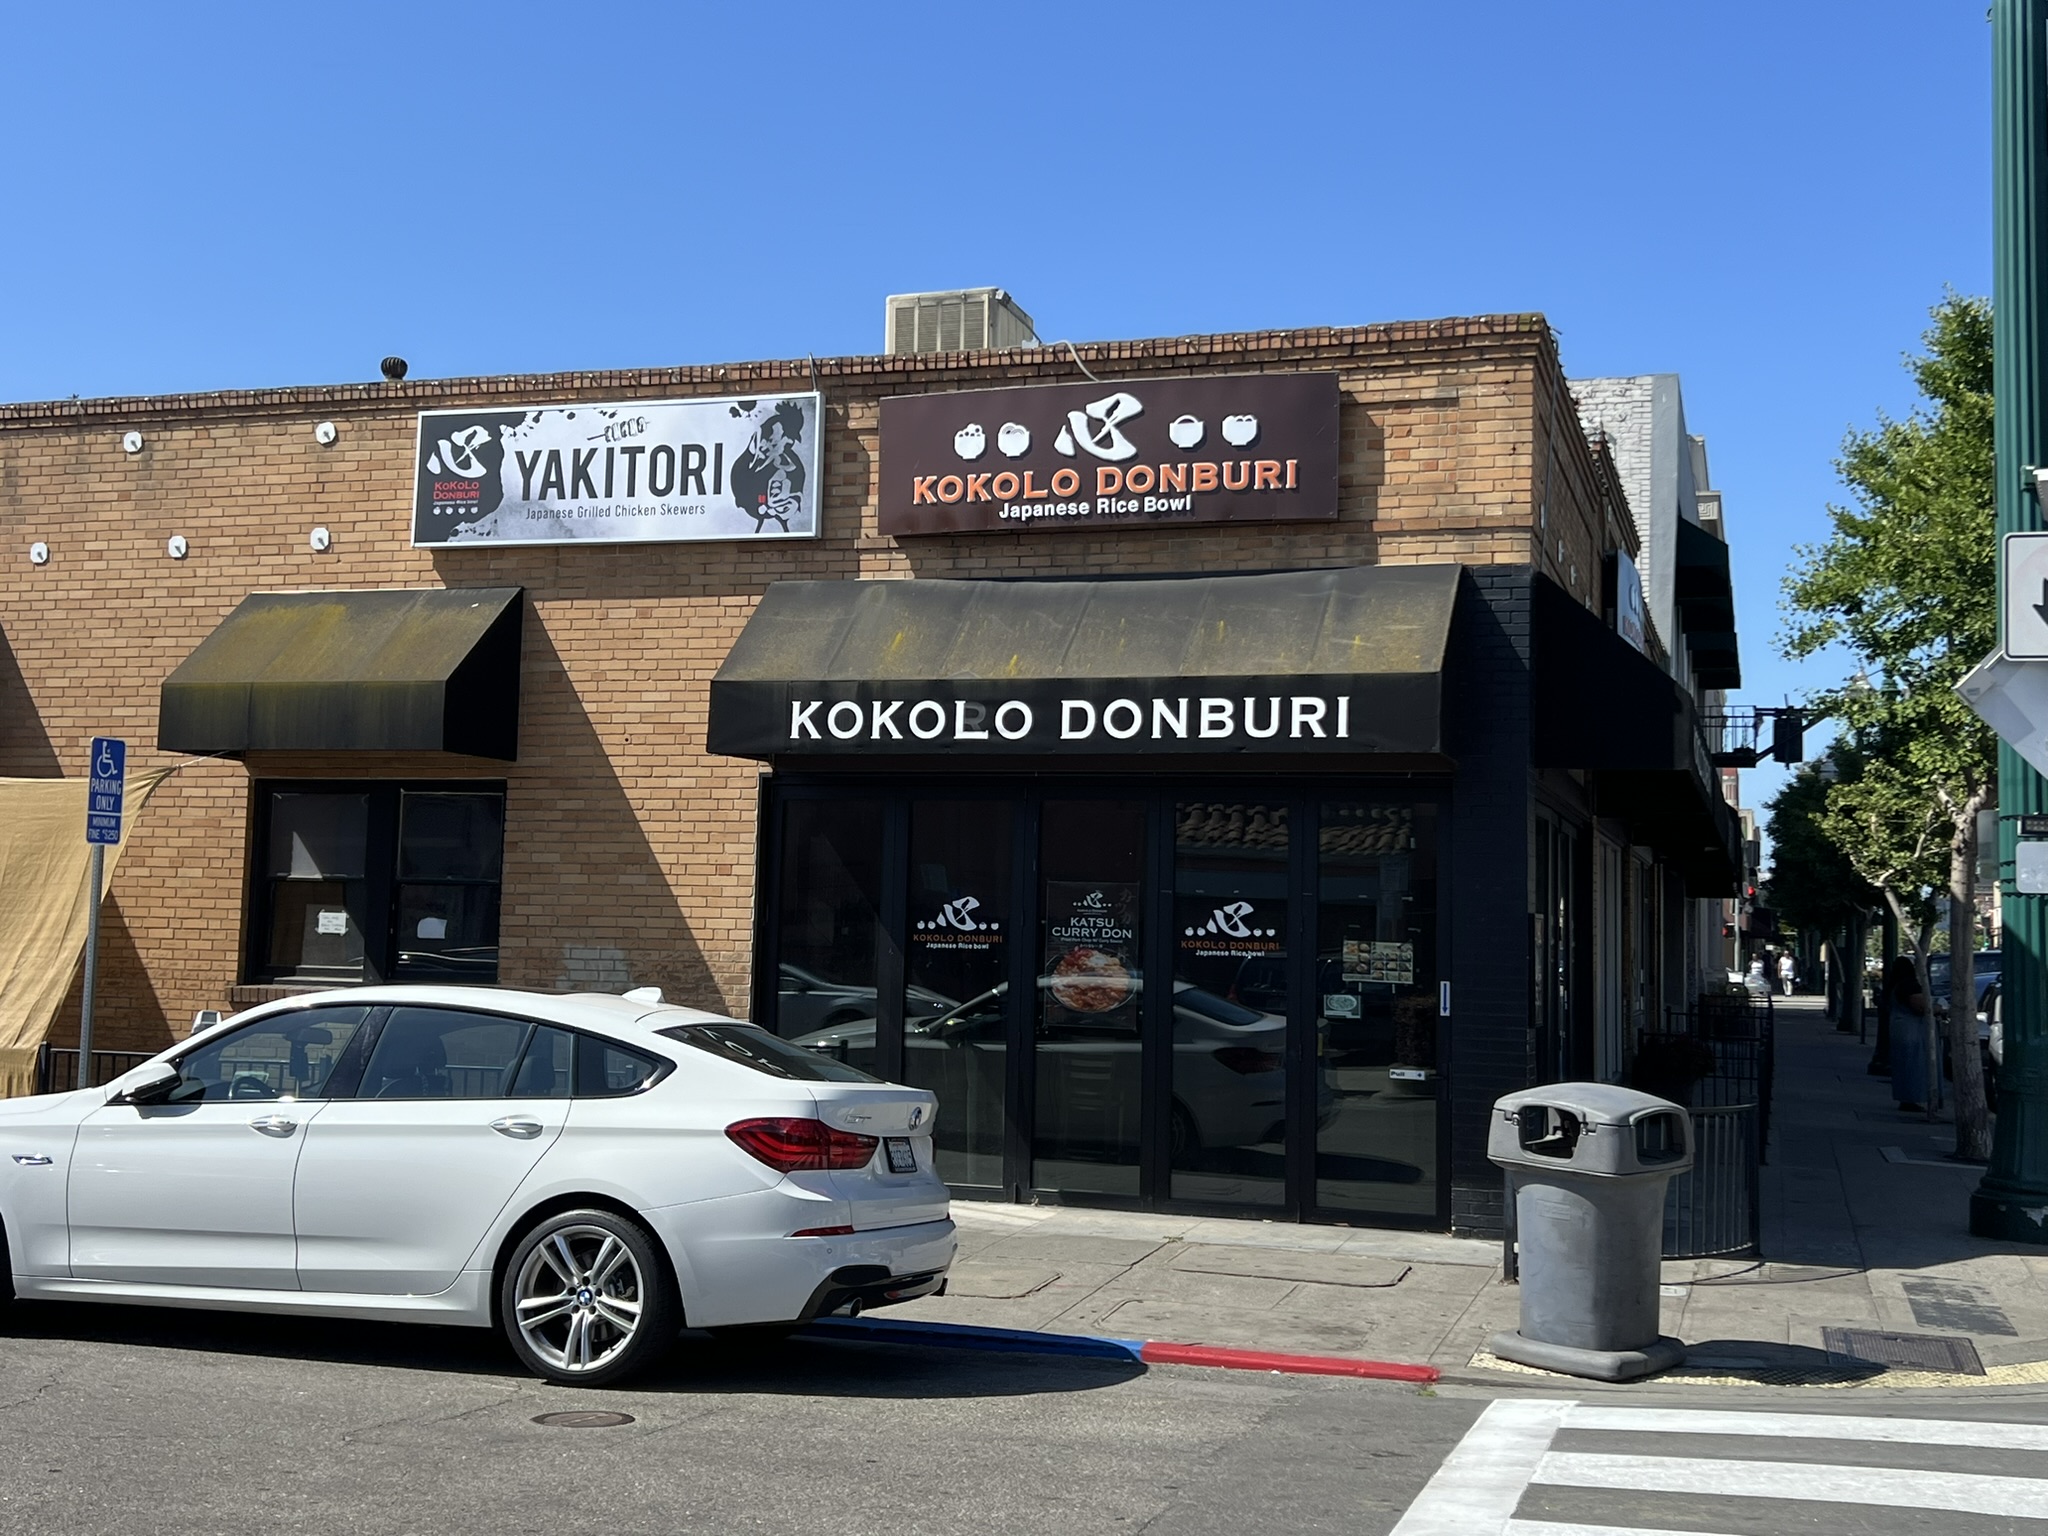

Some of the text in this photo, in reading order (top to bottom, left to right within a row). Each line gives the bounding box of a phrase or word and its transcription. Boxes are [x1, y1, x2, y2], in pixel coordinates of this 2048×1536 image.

[515, 443, 723, 501] YAKITORI
[434, 481, 480, 490] KOKOLO
[913, 459, 1298, 504] KOKOLO DONBURI
[433, 490, 480, 500] DONBURI
[525, 503, 706, 521] Japanese Grilled Chicken Skewers
[999, 494, 1191, 521] Japanese Rice Bowl
[790, 697, 1351, 741] KOKOLO DONBURI
[91, 777, 122, 795] PARKING
[95, 795, 115, 811] ONLY
[92, 815, 117, 828] MINIMUM
[1070, 917, 1115, 928] KATSU
[913, 933, 1003, 944] KOKOLO DONBURI
[1052, 927, 1132, 939] CURRY DON
[926, 942, 957, 950] Japanese
[1181, 940, 1280, 951] KOKOLO DONBURI
[1196, 949, 1229, 957] Japanese
[1231, 949, 1246, 957] Rice
